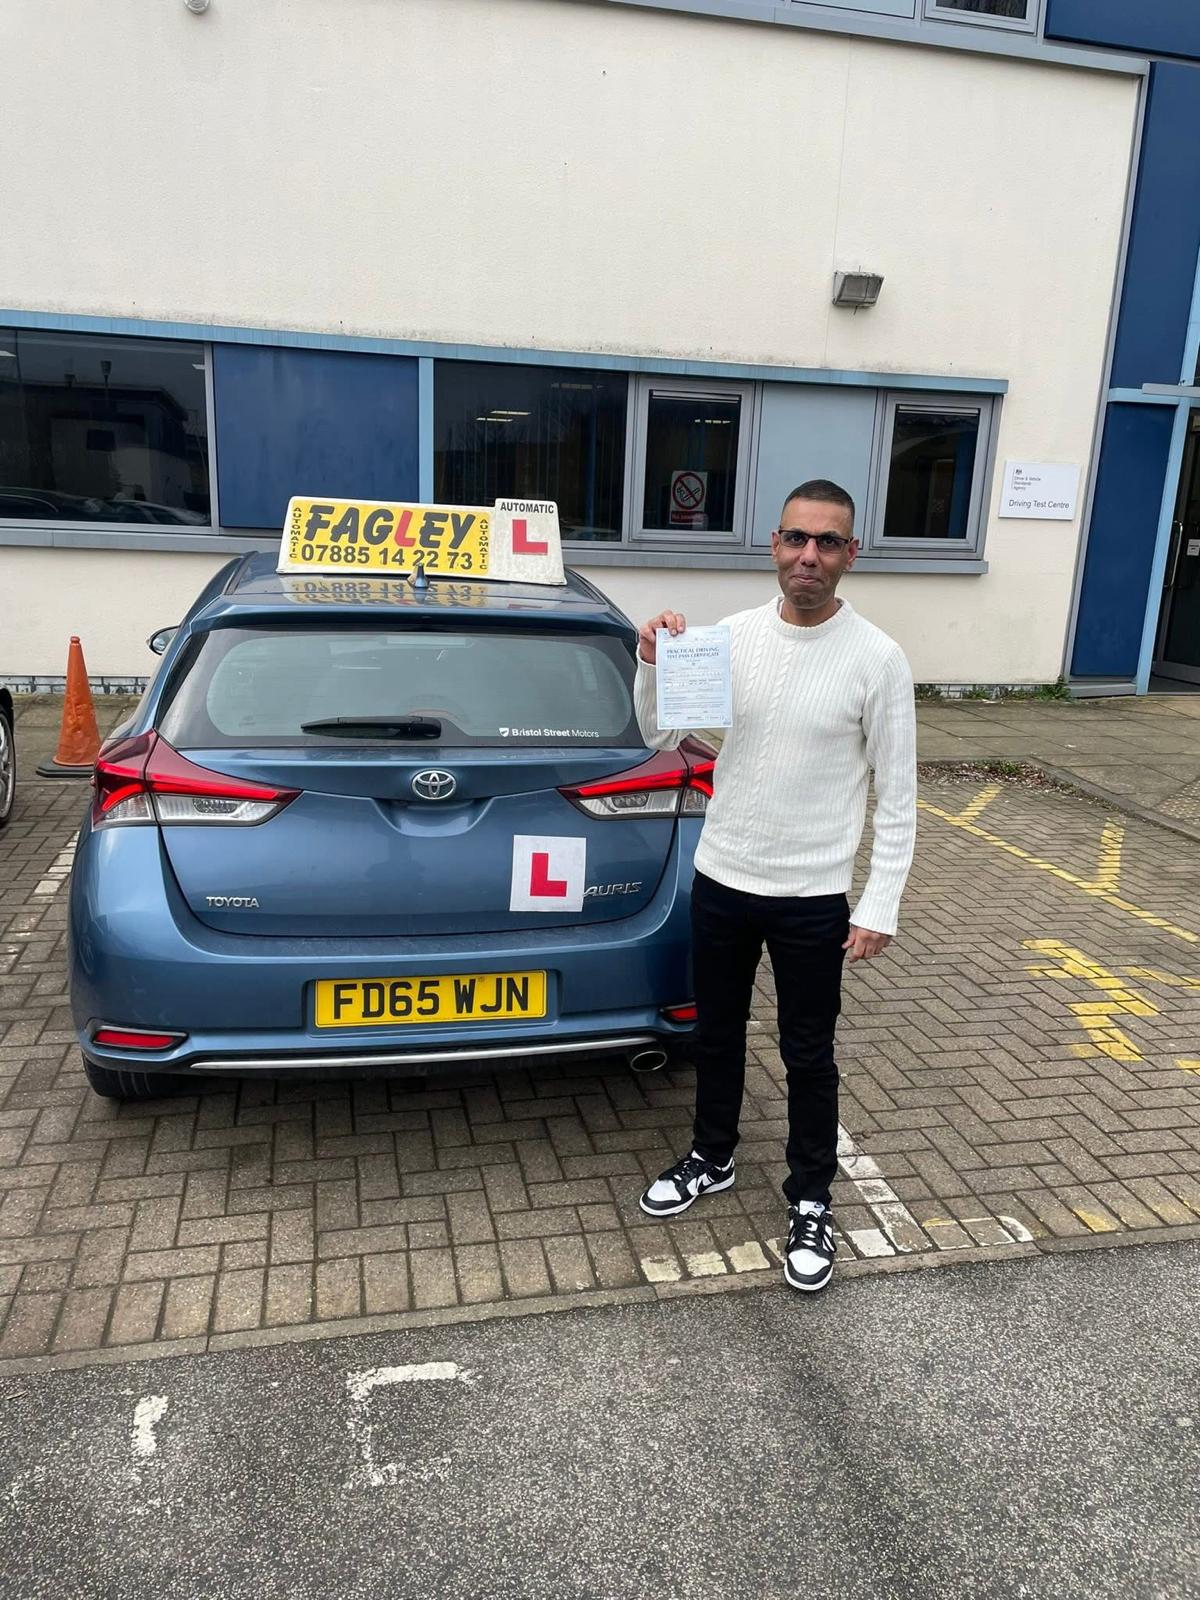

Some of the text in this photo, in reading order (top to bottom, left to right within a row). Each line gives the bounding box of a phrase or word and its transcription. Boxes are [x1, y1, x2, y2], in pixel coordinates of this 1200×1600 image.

[500, 501, 554, 514] AUTOMATIC
[1009, 499, 1070, 509] Driving Test Centre
[289, 507, 302, 559] AUTOMATIC
[303, 505, 476, 550] FAGLEY
[512, 519, 548, 555] L
[301, 544, 473, 570] 07885 14 22 73
[478, 518, 489, 570] AUTOMATIC
[511, 728, 600, 738] Bristol Street Motors
[530, 852, 567, 897] L
[583, 881, 642, 898] AURIS
[206, 895, 260, 909] TOYOTA
[333, 976, 529, 1019] FD65 WJN
